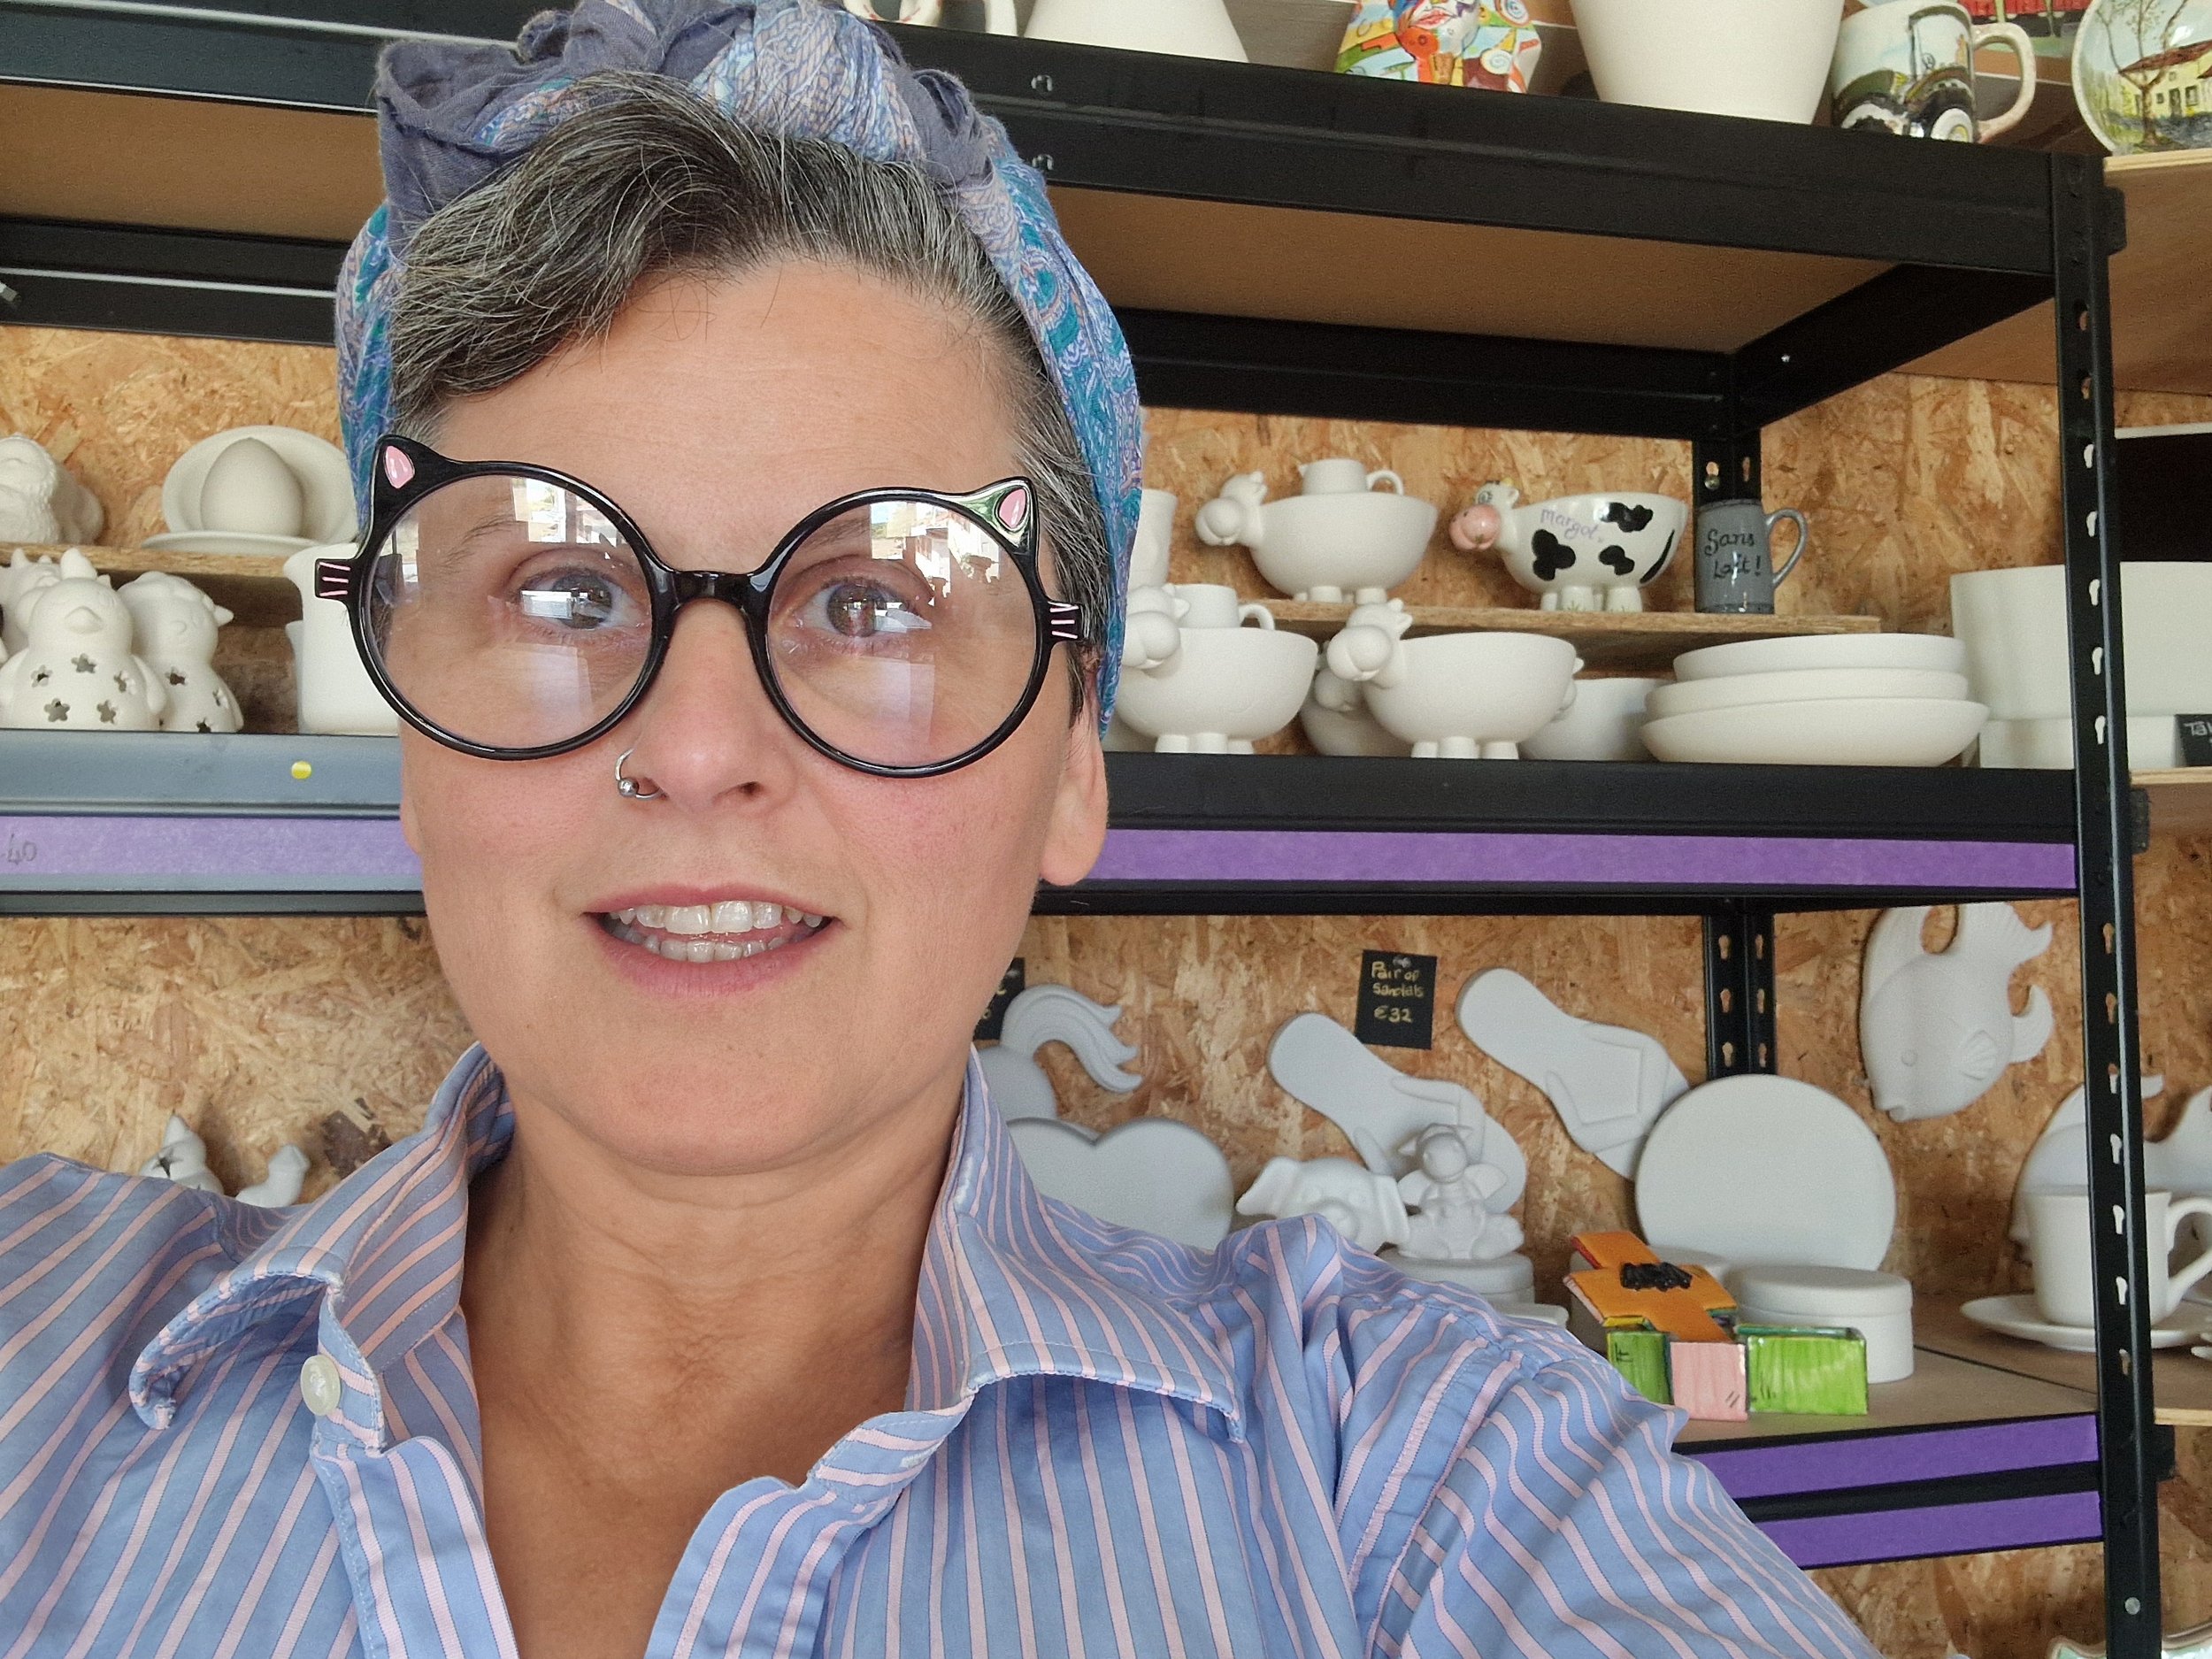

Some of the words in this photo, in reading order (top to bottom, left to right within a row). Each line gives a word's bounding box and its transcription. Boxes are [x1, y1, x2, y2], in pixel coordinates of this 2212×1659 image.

[1704, 529, 1755, 556] Sans
[1371, 961, 1402, 979] Pair
[1373, 1005, 1413, 1023] €32
